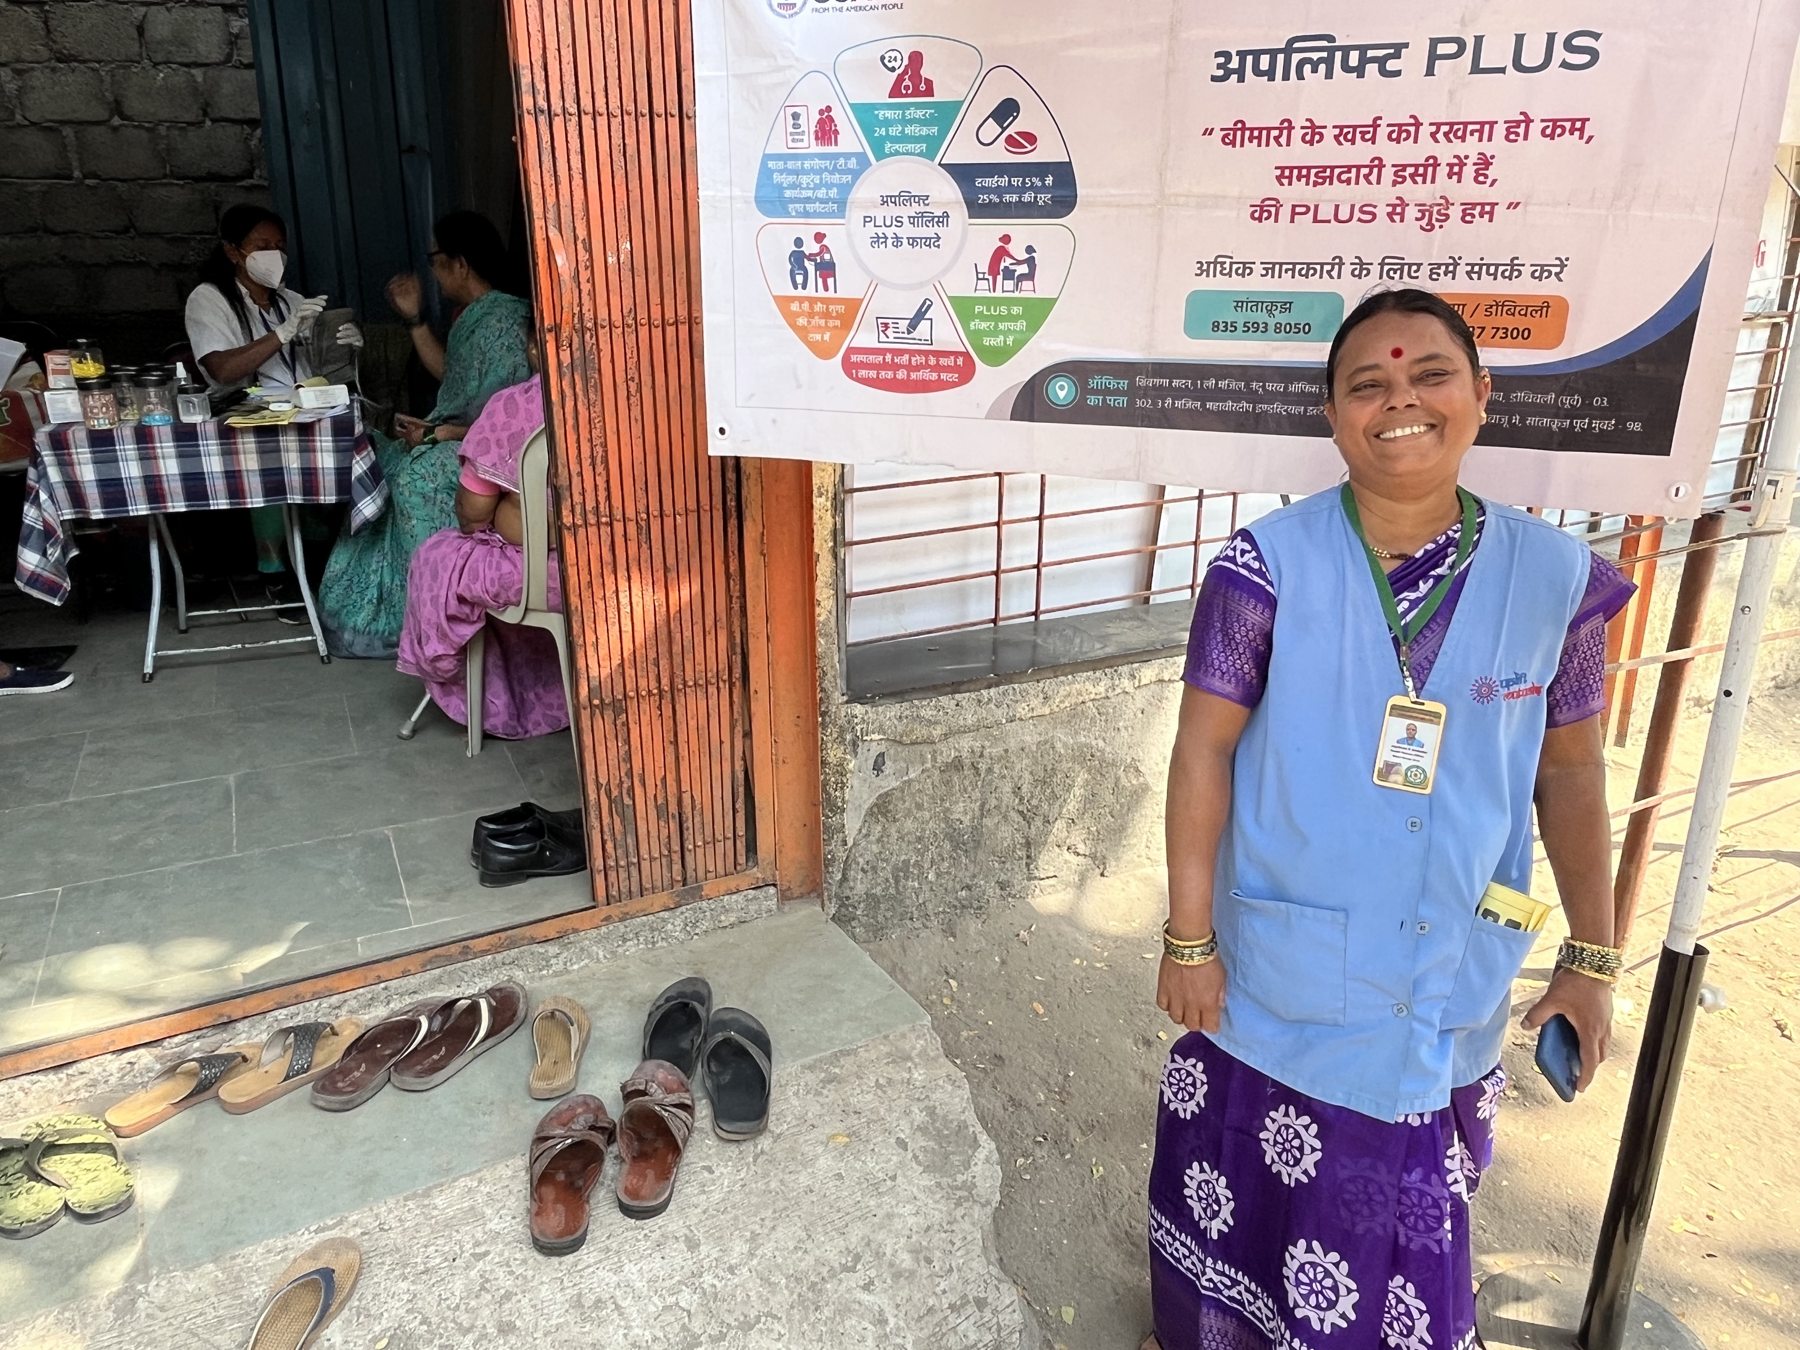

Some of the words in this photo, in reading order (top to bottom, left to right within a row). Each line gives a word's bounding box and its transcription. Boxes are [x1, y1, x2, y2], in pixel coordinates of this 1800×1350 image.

[845, 5, 879, 13] AMERICAN
[880, 3, 904, 11] PEOPLE
[887, 55, 898, 63] 24
[1210, 33, 1410, 84] अपलिफ्ट
[1423, 29, 1604, 78] PLUS
[874, 127, 886, 137] 24
[904, 123, 939, 136] मेडिकल
[1219, 119, 1295, 148] बीमारी
[1300, 118, 1327, 147] के
[1332, 116, 1382, 146] खर्च
[1386, 114, 1424, 145] को
[1428, 120, 1499, 144] रखना
[1503, 111, 1534, 143] हो
[1540, 117, 1595, 145] कम,
[884, 141, 927, 154] हेल्पलाइन
[1274, 156, 1386, 188] समझदारी
[1391, 155, 1441, 188] इसी
[1446, 154, 1470, 184] में
[1472, 152, 1499, 188] हैं,
[1010, 177, 1023, 187] पर
[1025, 177, 1042, 187] 5%
[1044, 174, 1054, 187] से
[879, 190, 931, 207] अपलिफ्ट
[977, 194, 1000, 204] 25%
[1002, 194, 1019, 204] तक
[1021, 191, 1034, 203] की
[863, 214, 904, 228] PLUS
[908, 211, 950, 228] पॉलिसी
[1249, 197, 1284, 224] की
[1289, 203, 1378, 224] PLUS
[1385, 196, 1410, 224] से
[1414, 195, 1455, 233] जुड़े
[1460, 201, 1499, 225] हम
[870, 233, 888, 249] लेने
[891, 233, 903, 249] के
[906, 232, 941, 249] फायदे
[1194, 254, 1256, 279] अधिक
[1260, 255, 1345, 280] जानकारी
[1350, 255, 1374, 280] के
[1378, 255, 1423, 280] लिए
[1428, 255, 1463, 282] हमें
[1465, 256, 1525, 282] संपर्क
[1530, 256, 1570, 282] करें
[974, 305, 1008, 315] PLUS
[1010, 306, 1023, 316] का
[1232, 297, 1294, 319] सांताक्रूझ
[1484, 300, 1551, 318] डोंबिवली
[998, 319, 1027, 332] आपकी
[1211, 320, 1238, 333] 835
[1241, 321, 1269, 334] 593
[1273, 322, 1312, 335] 8050
[1490, 326, 1532, 341] 7300
[850, 354, 883, 364] अस्पताल
[927, 355, 937, 366] के
[852, 370, 856, 378] 1
[858, 369, 878, 379] लाख
[878, 370, 894, 379] तक
[895, 369, 907, 380] की
[1087, 375, 1129, 390] ऑफिस
[1086, 395, 1104, 407] का
[1105, 396, 1129, 408] पता
